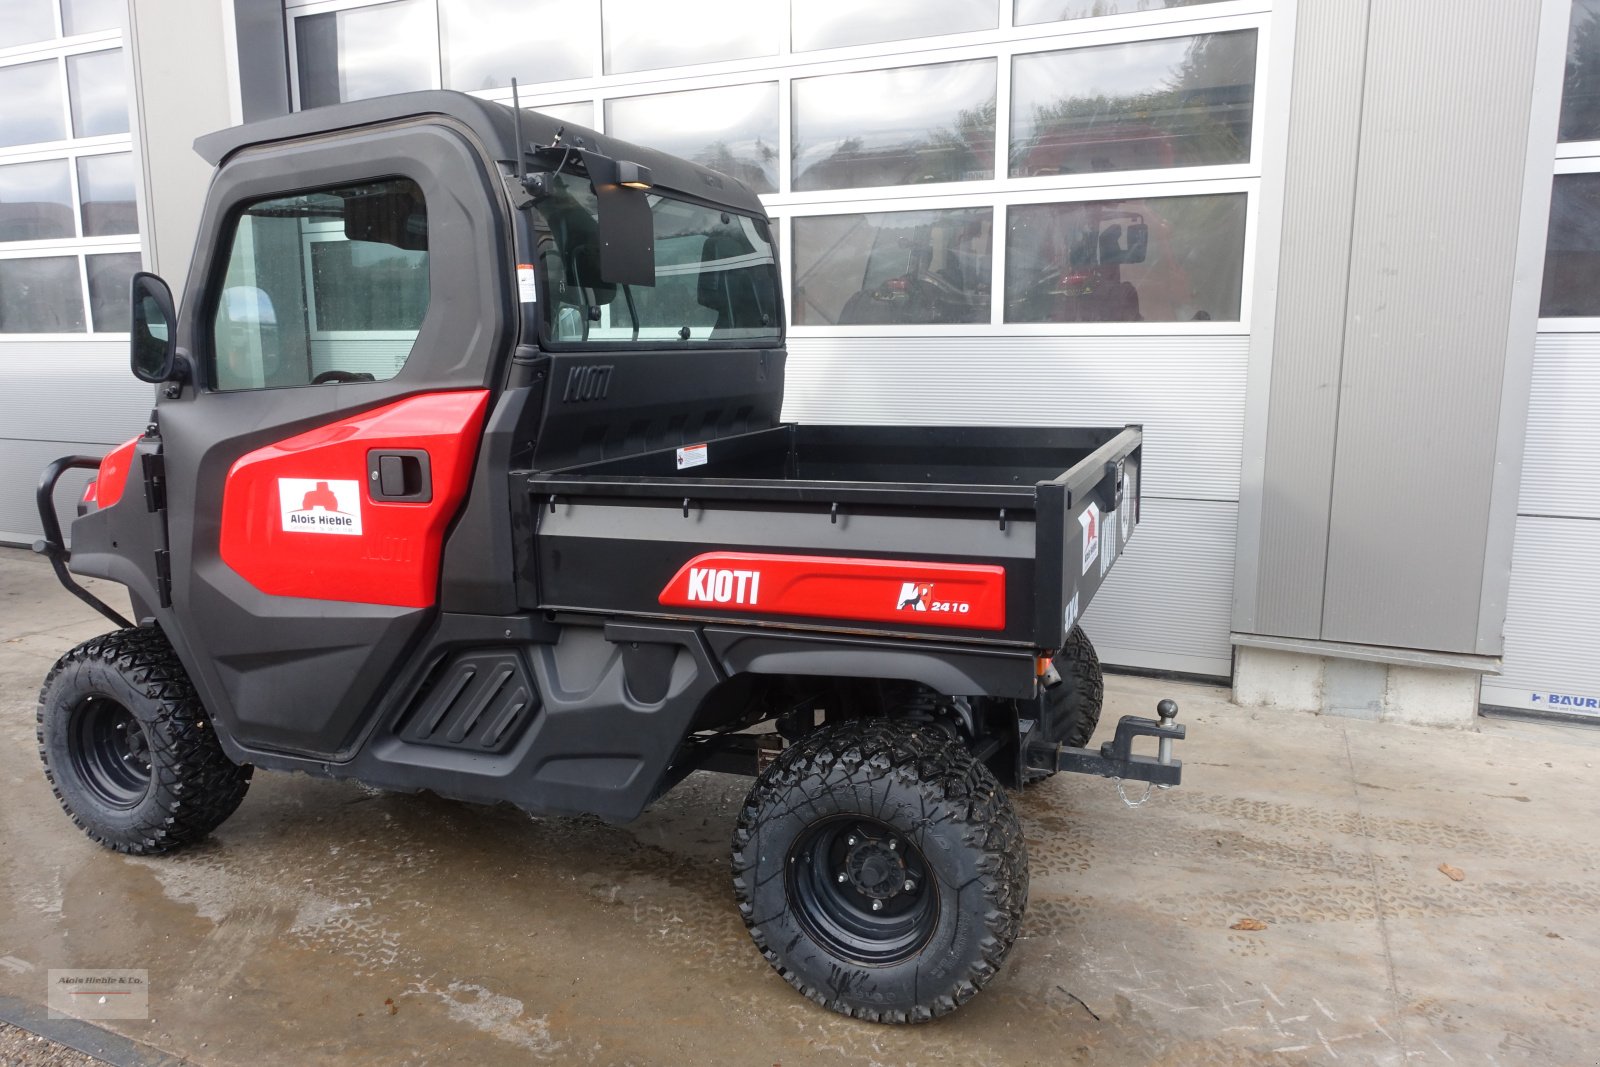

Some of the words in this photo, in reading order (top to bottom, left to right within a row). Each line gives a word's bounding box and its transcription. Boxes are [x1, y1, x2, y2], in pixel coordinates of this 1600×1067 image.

[563, 365, 614, 400] KIOTI
[290, 514, 316, 524] Alois
[318, 515, 352, 526] Hieble
[687, 568, 760, 605] KIOTI
[930, 601, 969, 613] 2410
